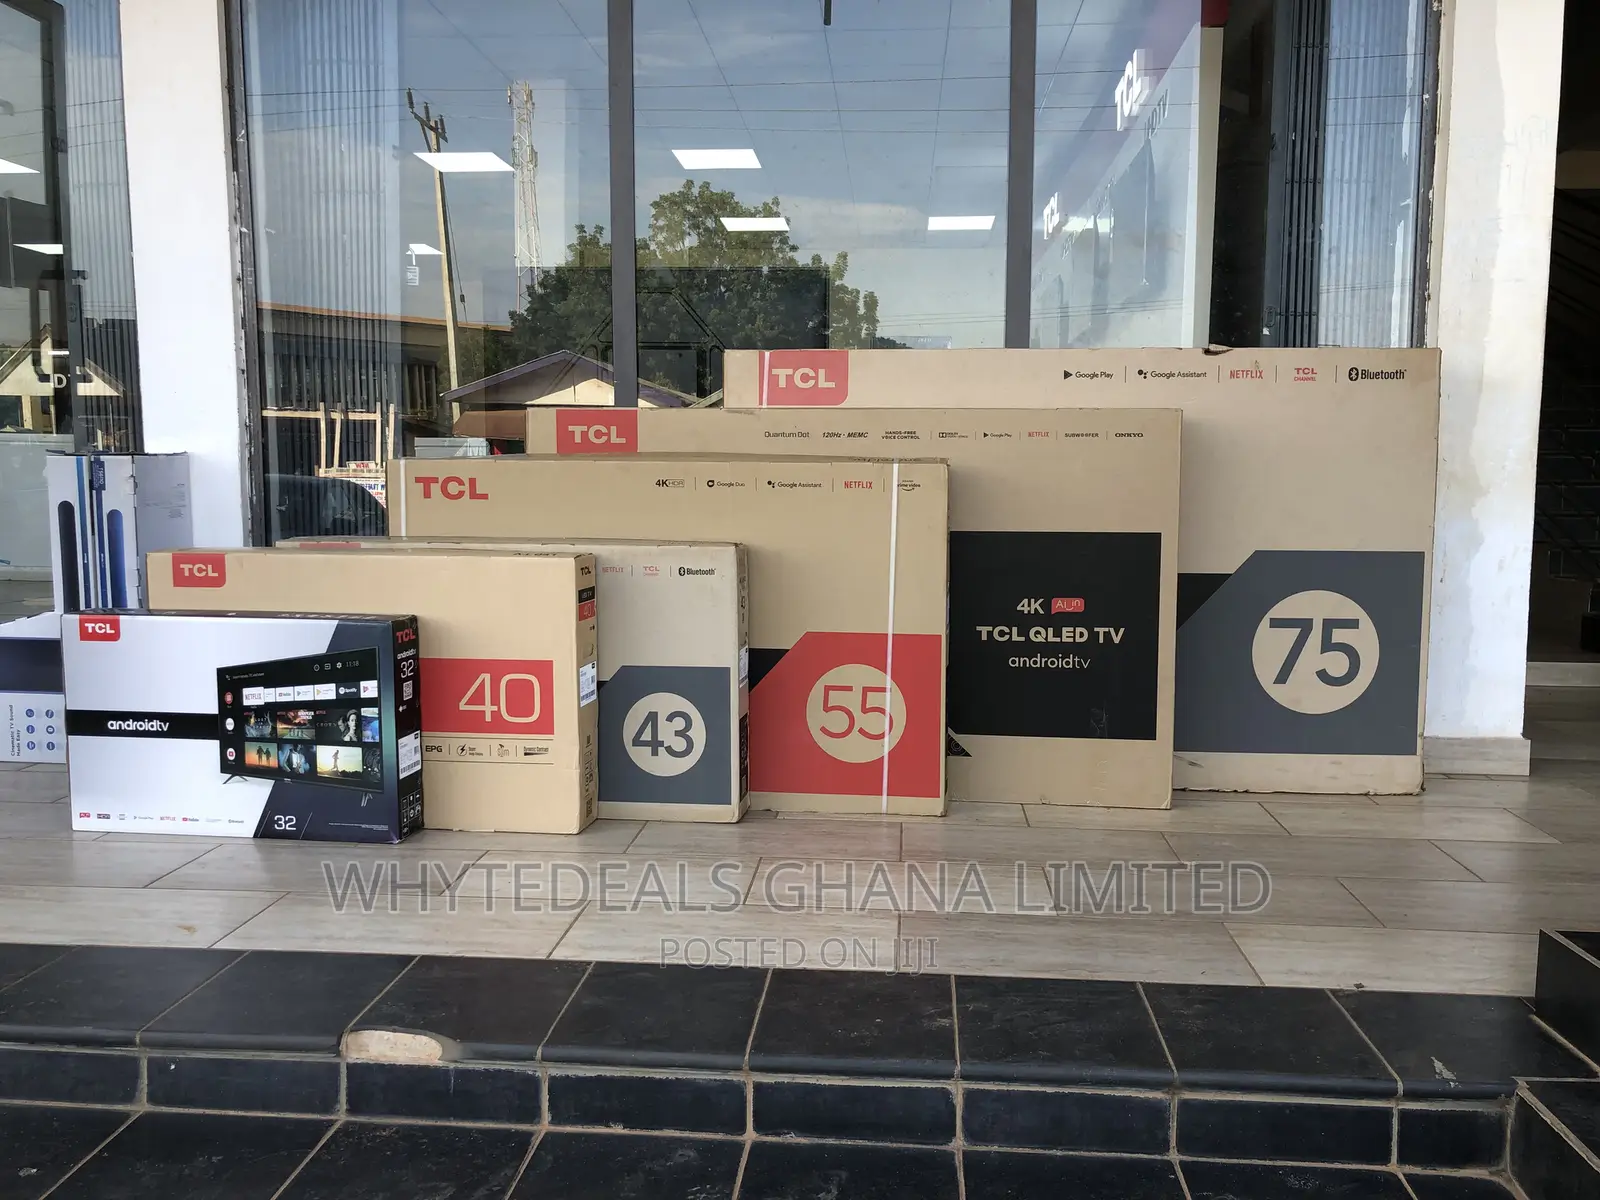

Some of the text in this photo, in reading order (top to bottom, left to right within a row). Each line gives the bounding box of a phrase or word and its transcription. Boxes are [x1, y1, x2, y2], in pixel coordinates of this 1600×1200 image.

[1114, 49, 1147, 132] TCL
[1043, 191, 1060, 240] TCL
[771, 367, 836, 388] TCL
[1075, 371, 1114, 380] Google Play
[1150, 370, 1207, 380] Google Assistant
[1229, 369, 1263, 380] NETFLIX
[1294, 367, 1318, 375] TCL
[1360, 368, 1405, 380] Bluetooth
[568, 425, 626, 444] TCL
[822, 431, 869, 439] 120Hz MEMC
[415, 476, 489, 500] TCL
[844, 481, 873, 489] NETFLIX
[180, 563, 219, 577] TCL
[580, 566, 592, 576] TCL
[686, 567, 715, 576] Bluetooth
[1016, 598, 1045, 614] 4K
[84, 622, 116, 634] TCL
[396, 628, 416, 643] TCL
[976, 625, 1126, 643] TCL QLED TV
[1269, 617, 1361, 687] 75
[400, 659, 414, 679] 32
[459, 672, 541, 723] 40
[819, 684, 894, 740] 55
[631, 710, 695, 759] 43
[425, 745, 443, 753] EPG
[274, 815, 297, 830] 32
